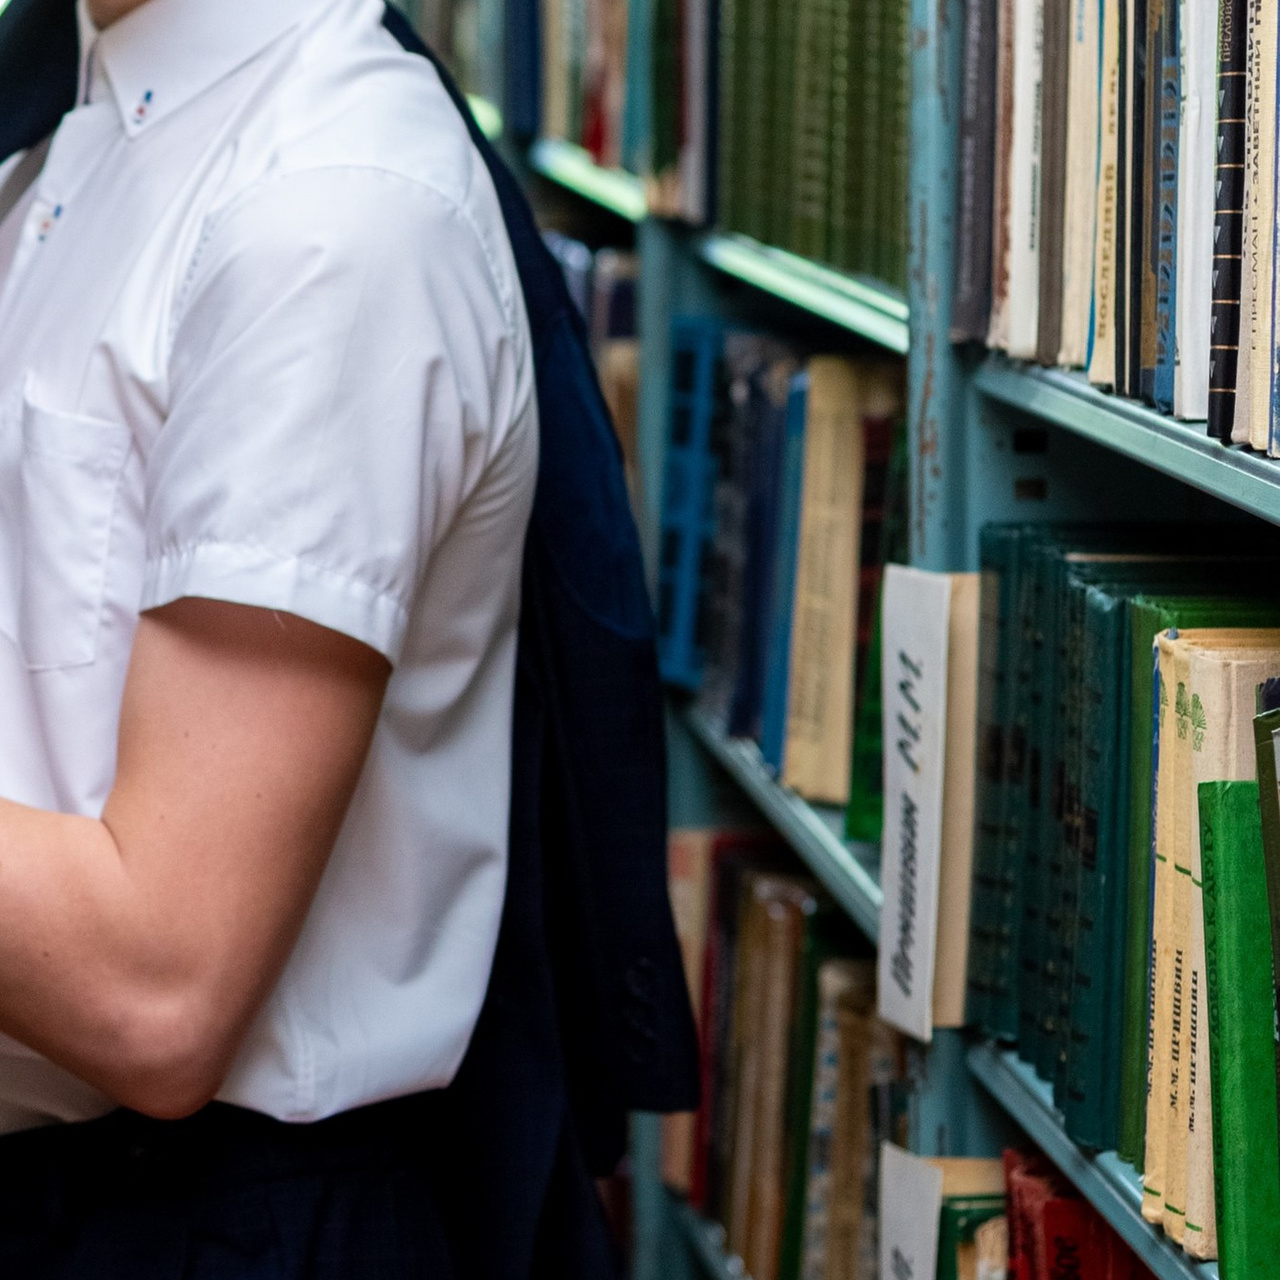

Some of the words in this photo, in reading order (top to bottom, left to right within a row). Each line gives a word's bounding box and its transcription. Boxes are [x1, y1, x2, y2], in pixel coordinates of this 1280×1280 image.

[1252, 41, 1261, 185] ЗАВЕТНЫЙ
[1097, 163, 1115, 339] ПОСЛЕДНИЙ
[1205, 908, 1217, 927] К
[1171, 949, 1183, 1062] ПРИШВИН
[1207, 935, 1221, 1039] ДОРОГА
